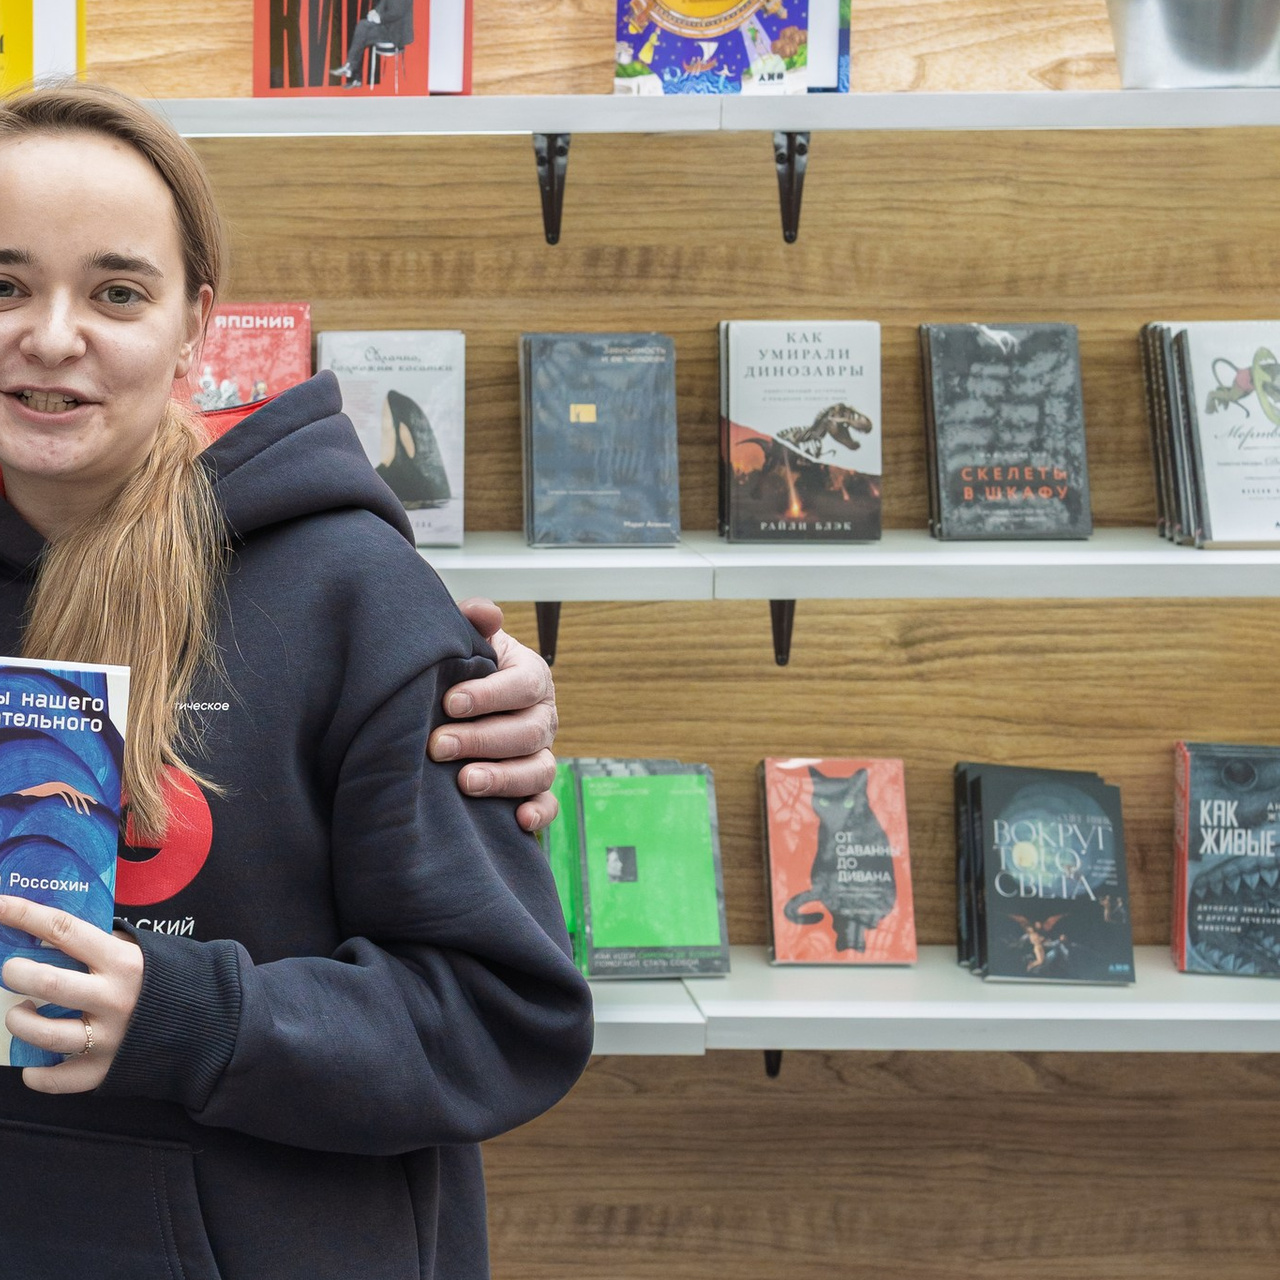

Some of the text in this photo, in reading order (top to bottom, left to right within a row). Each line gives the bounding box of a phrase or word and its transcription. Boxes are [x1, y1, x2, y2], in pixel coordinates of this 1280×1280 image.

[214, 315, 295, 329] ЯПОНИЯ
[786, 331, 823, 344] КАК
[758, 348, 851, 361] УМИРАЛИ
[743, 364, 865, 379] ДИНОЗАВРЫ
[960, 466, 1068, 482] СКЕЛЕТЫ
[963, 486, 1068, 501] В ШКАФУ
[759, 521, 853, 531] РАЙЛИ БЛЭК
[20, 692, 105, 713] нашего
[1199, 799, 1239, 828] КАК
[834, 831, 853, 843] ОТ
[992, 819, 1113, 855] ВОКРУГ
[1198, 827, 1277, 857] ЖИВЫЕ
[835, 844, 901, 857] САВАННЫ
[836, 856, 858, 870] ДО
[992, 845, 1082, 874] ТОГО
[9, 872, 90, 893] Россохин
[837, 869, 892, 883] ДИВАНА
[994, 870, 1096, 901] СВЕТА
